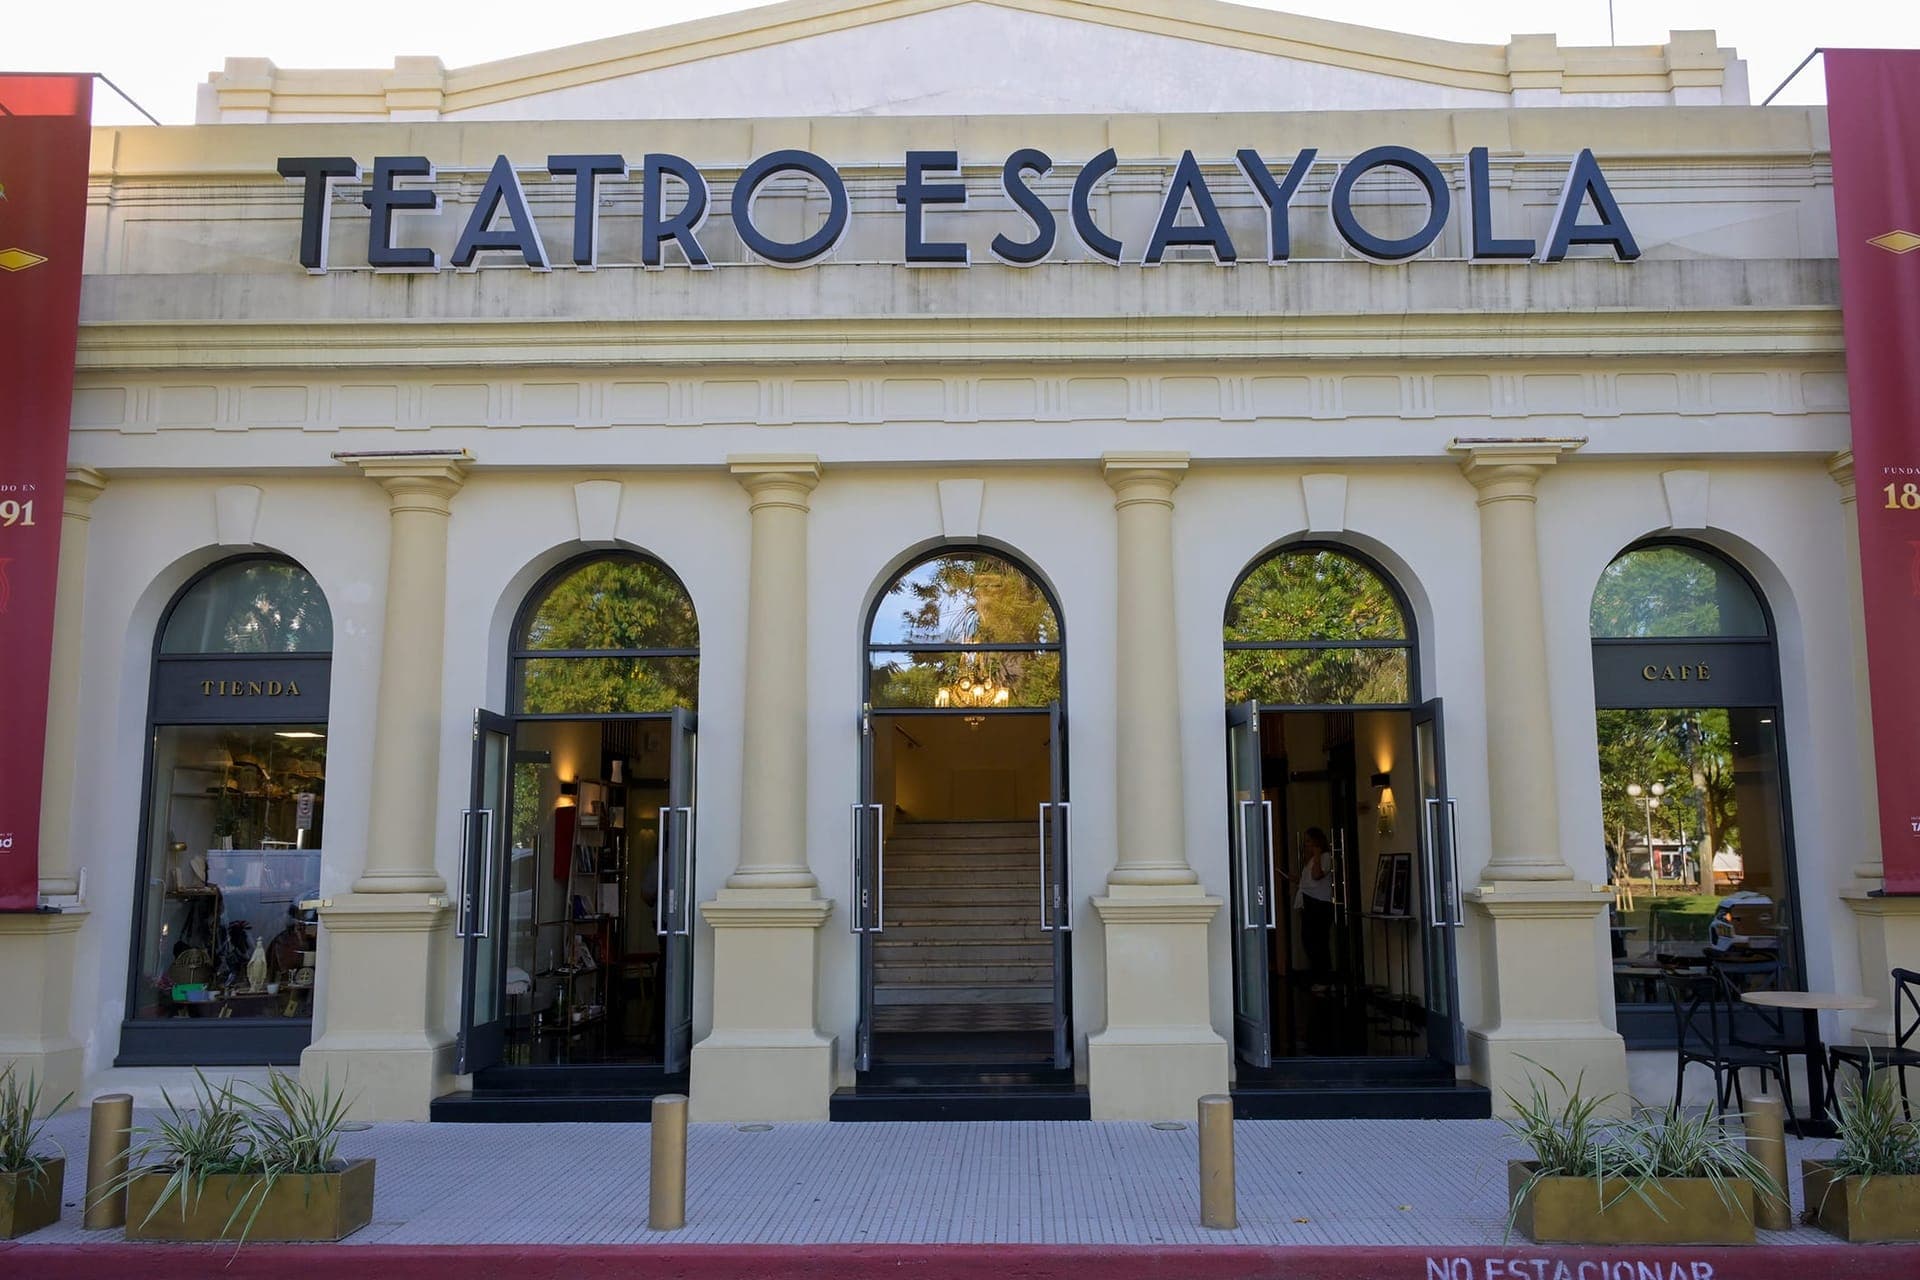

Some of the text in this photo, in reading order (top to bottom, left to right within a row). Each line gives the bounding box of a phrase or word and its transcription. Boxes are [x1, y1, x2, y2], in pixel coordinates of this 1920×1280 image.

[277, 146, 1642, 273] TEATRO ESCAYOLA
[1883, 483, 1920, 509] 18
[0, 500, 36, 527] 91
[1642, 659, 1711, 681] CAFÉ
[201, 680, 301, 696] TIENDA
[1426, 1257, 1714, 1280] NO ESTACIONAR
